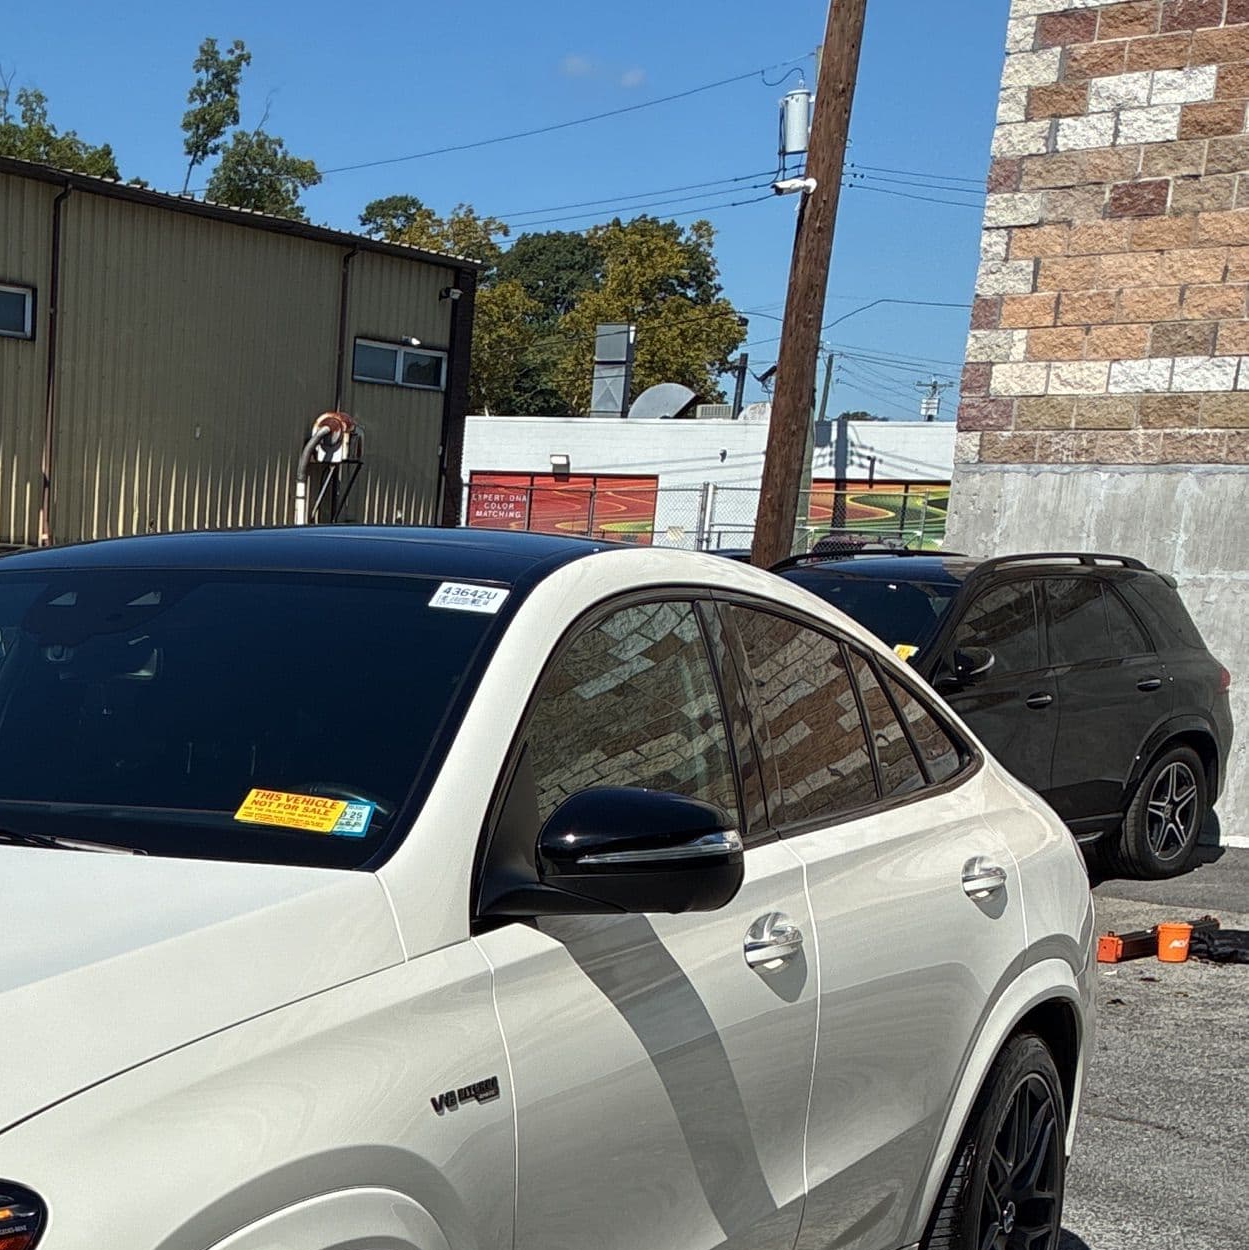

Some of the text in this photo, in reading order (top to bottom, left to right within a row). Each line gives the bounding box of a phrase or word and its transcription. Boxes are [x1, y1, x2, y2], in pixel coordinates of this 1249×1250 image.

[471, 494, 505, 502] EXPERT
[483, 502, 514, 510] COLOR
[475, 510, 522, 518] MATCHING
[443, 586, 498, 600] 43642U
[254, 791, 282, 801] THIS
[285, 795, 340, 810] VEHICLE
[251, 799, 275, 808] NOT
[276, 802, 299, 811] FOR
[302, 806, 331, 816] SALE
